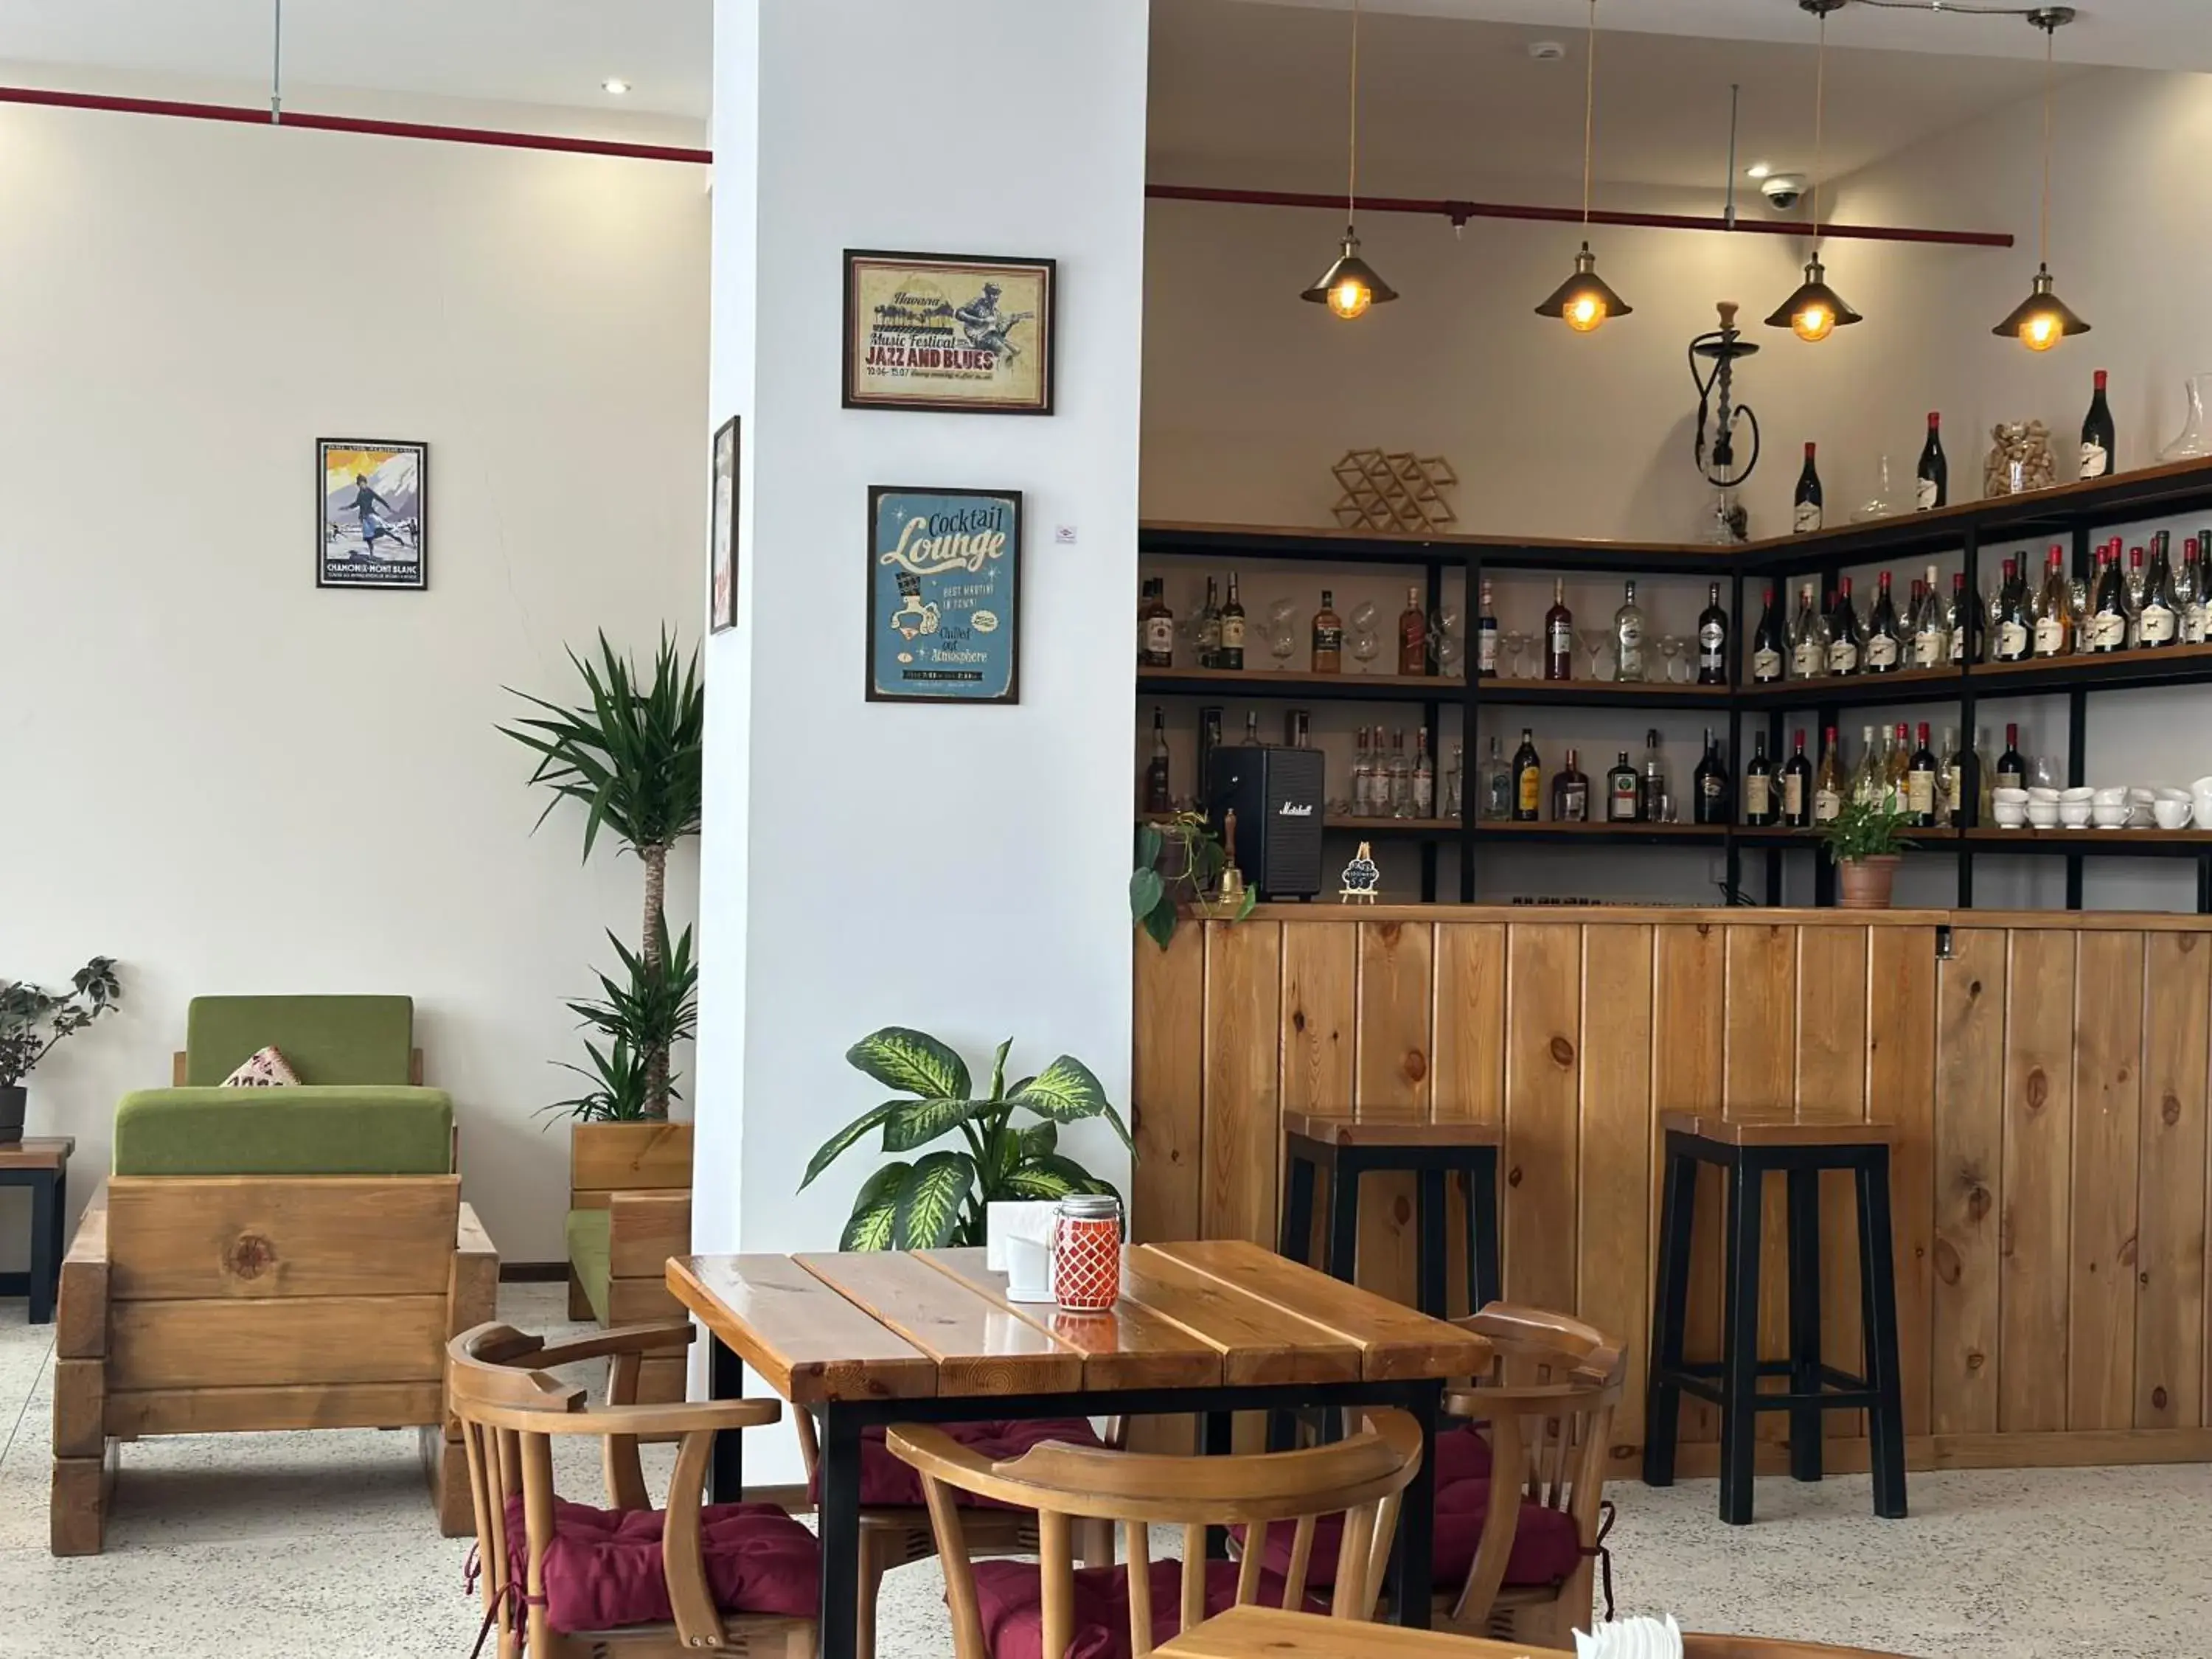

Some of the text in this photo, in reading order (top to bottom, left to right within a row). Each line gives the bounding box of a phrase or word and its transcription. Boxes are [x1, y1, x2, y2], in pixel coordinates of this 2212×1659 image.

[871, 332, 956, 348] Music Festival
[866, 347, 994, 370] JAZZ AND BLUES
[928, 507, 1003, 538] Cocktail
[880, 517, 1006, 575] Lounge
